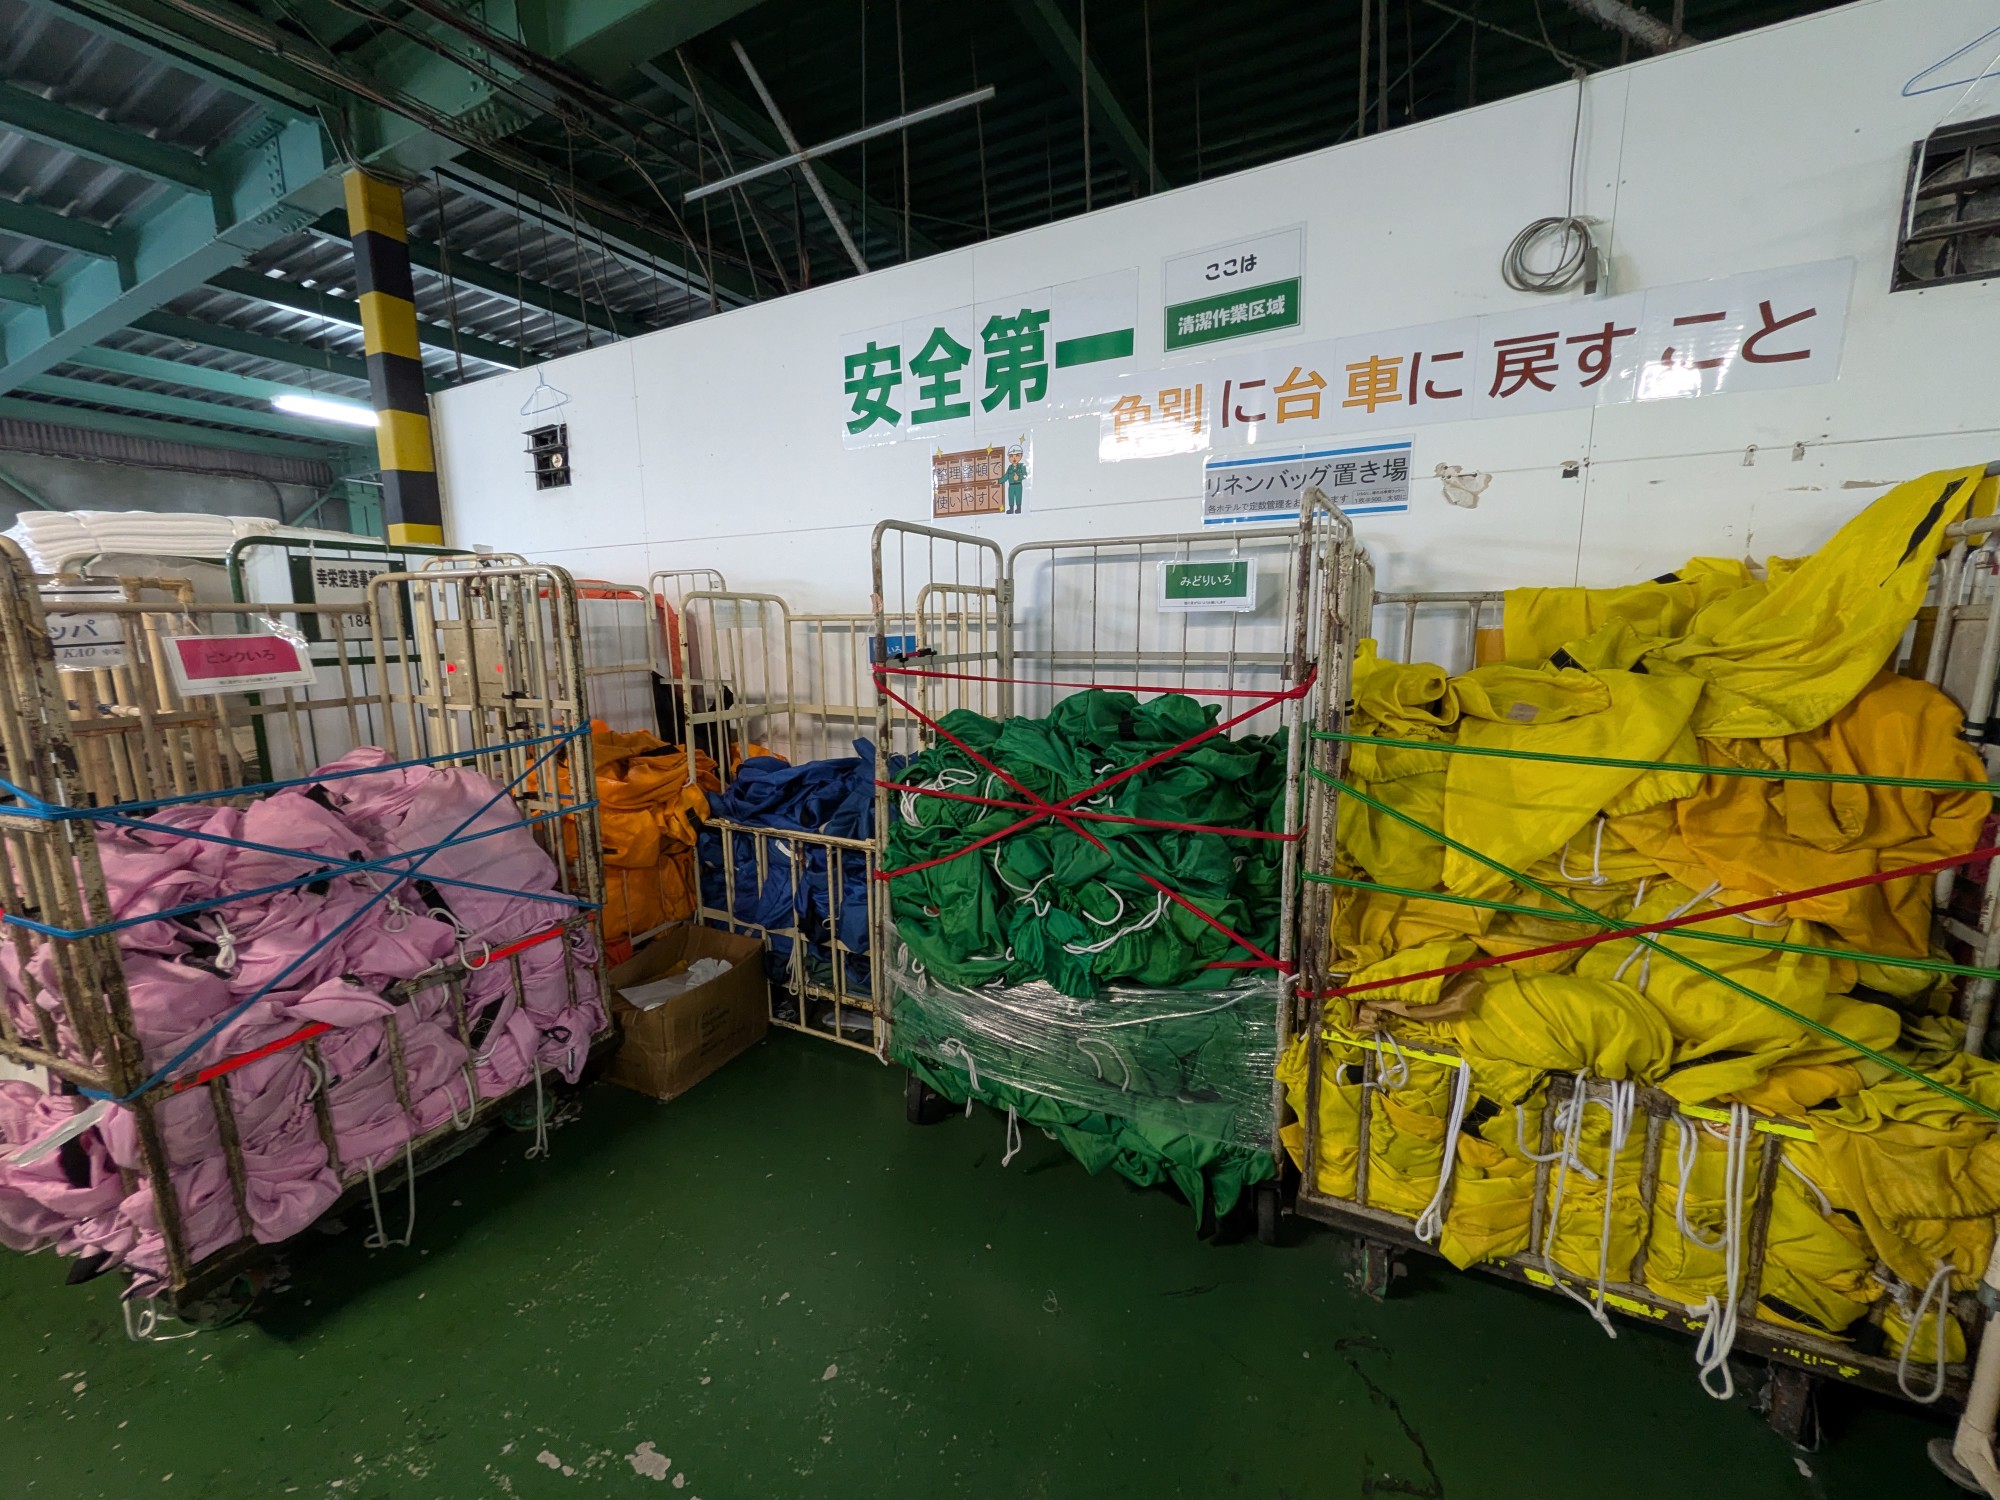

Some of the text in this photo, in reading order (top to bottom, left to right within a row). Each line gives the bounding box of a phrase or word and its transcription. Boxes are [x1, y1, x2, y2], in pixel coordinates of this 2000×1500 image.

[1205, 254, 1257, 280] ここは
[1178, 294, 1285, 335] 清潔作業区域
[844, 308, 1135, 434] 安全第一
[936, 461, 1002, 482] 整理整頓で
[1207, 457, 1409, 497] リネンバッグ置き場
[937, 490, 999, 510] 使いやすく
[1180, 574, 1232, 587] みどりいろ
[206, 649, 276, 664] ピンクいろ
